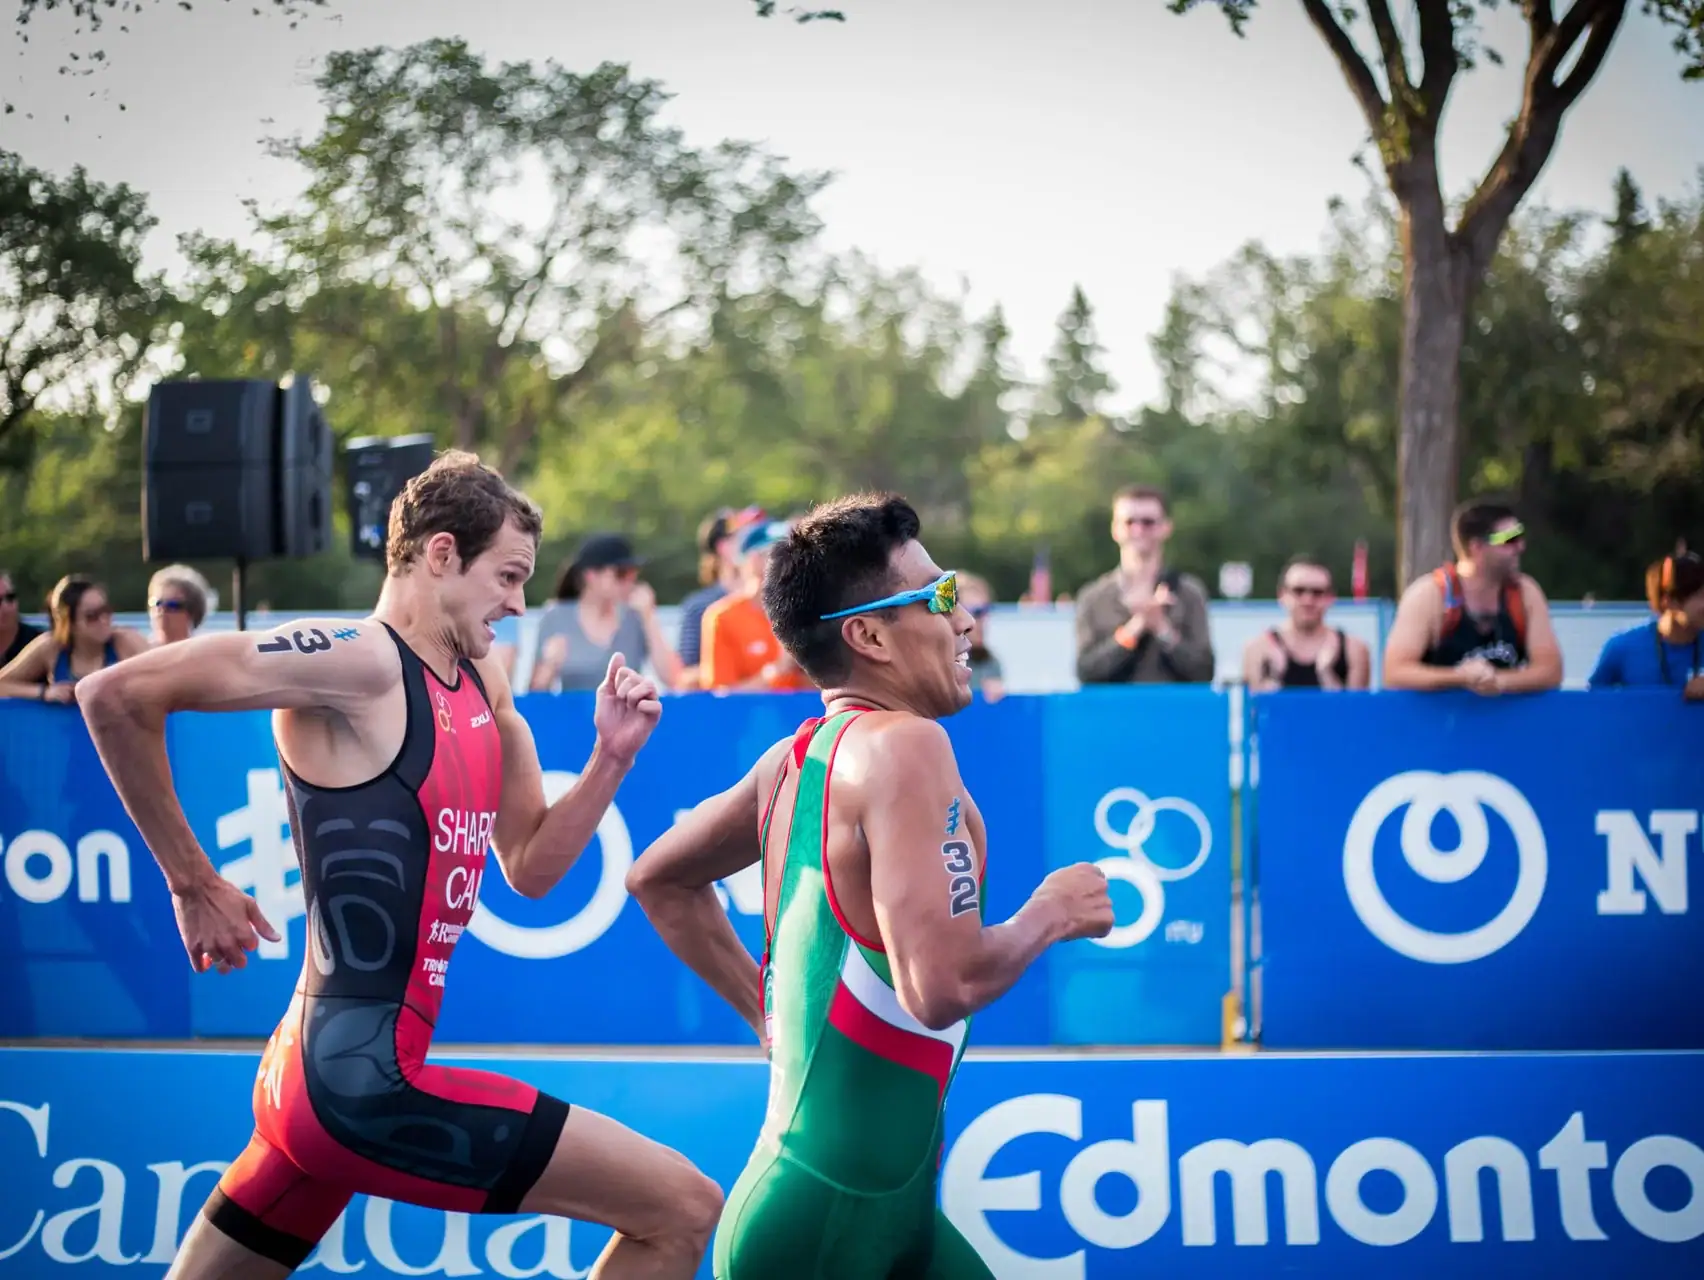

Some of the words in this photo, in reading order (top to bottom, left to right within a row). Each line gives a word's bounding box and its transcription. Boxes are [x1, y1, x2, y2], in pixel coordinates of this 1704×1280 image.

[0, 829, 131, 903] on
[941, 840, 979, 917] 32
[1594, 809, 1704, 915] N
